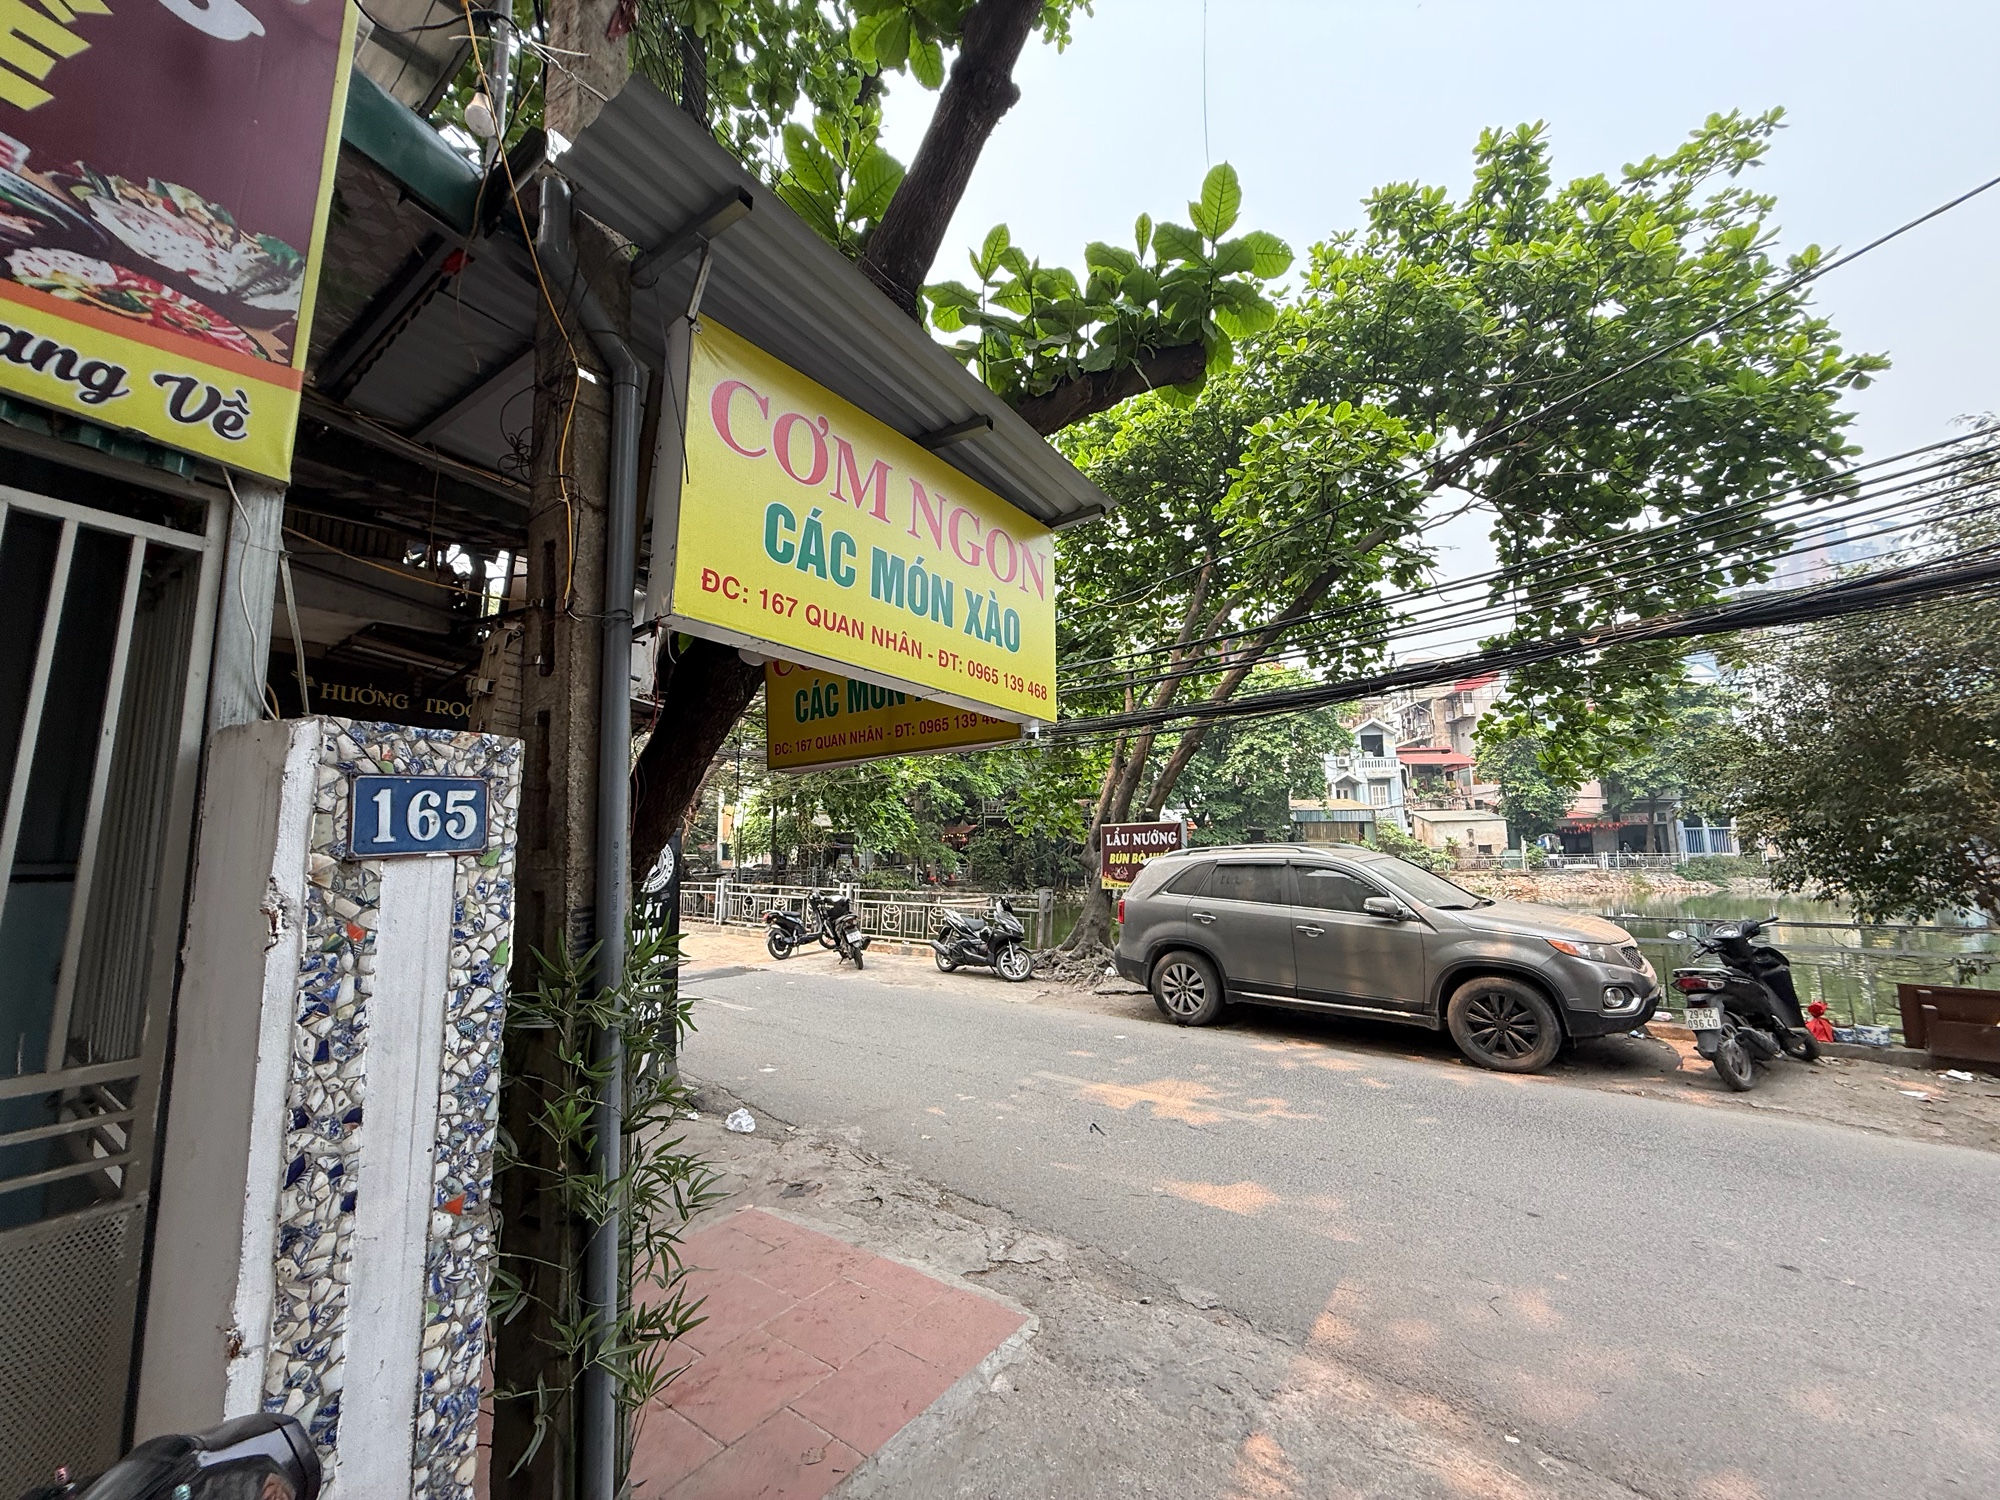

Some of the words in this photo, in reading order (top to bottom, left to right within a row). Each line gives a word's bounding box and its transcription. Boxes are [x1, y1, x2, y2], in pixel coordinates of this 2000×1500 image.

[154, 374, 250, 440] Về
[711, 380, 893, 524] CƠM
[907, 477, 1046, 601] NGON
[764, 502, 857, 589] CÁC
[870, 546, 954, 629] MÓN
[963, 588, 1020, 653] XÀO
[701, 567, 749, 604] ĐC:
[759, 588, 798, 618] 167
[805, 604, 864, 641] QUAN
[871, 625, 922, 660] NHÂN
[938, 649, 963, 674] ĐT:
[967, 659, 999, 685] 0965
[1003, 672, 1024, 693] 139
[1028, 681, 1048, 701] 468
[795, 678, 839, 723] CÁC
[774, 742, 793, 756] ĐC:
[795, 738, 812, 753] 167
[815, 732, 846, 750] QUAN
[850, 725, 883, 745] NHÂN
[894, 722, 915, 738] ĐT:
[919, 716, 949, 735] 0965
[953, 712, 978, 729] 139
[373, 788, 478, 843] 165
[1106, 826, 1130, 846] LẨU
[1133, 828, 1177, 846] NƯỚNG
[1109, 850, 1130, 864] BÚN
